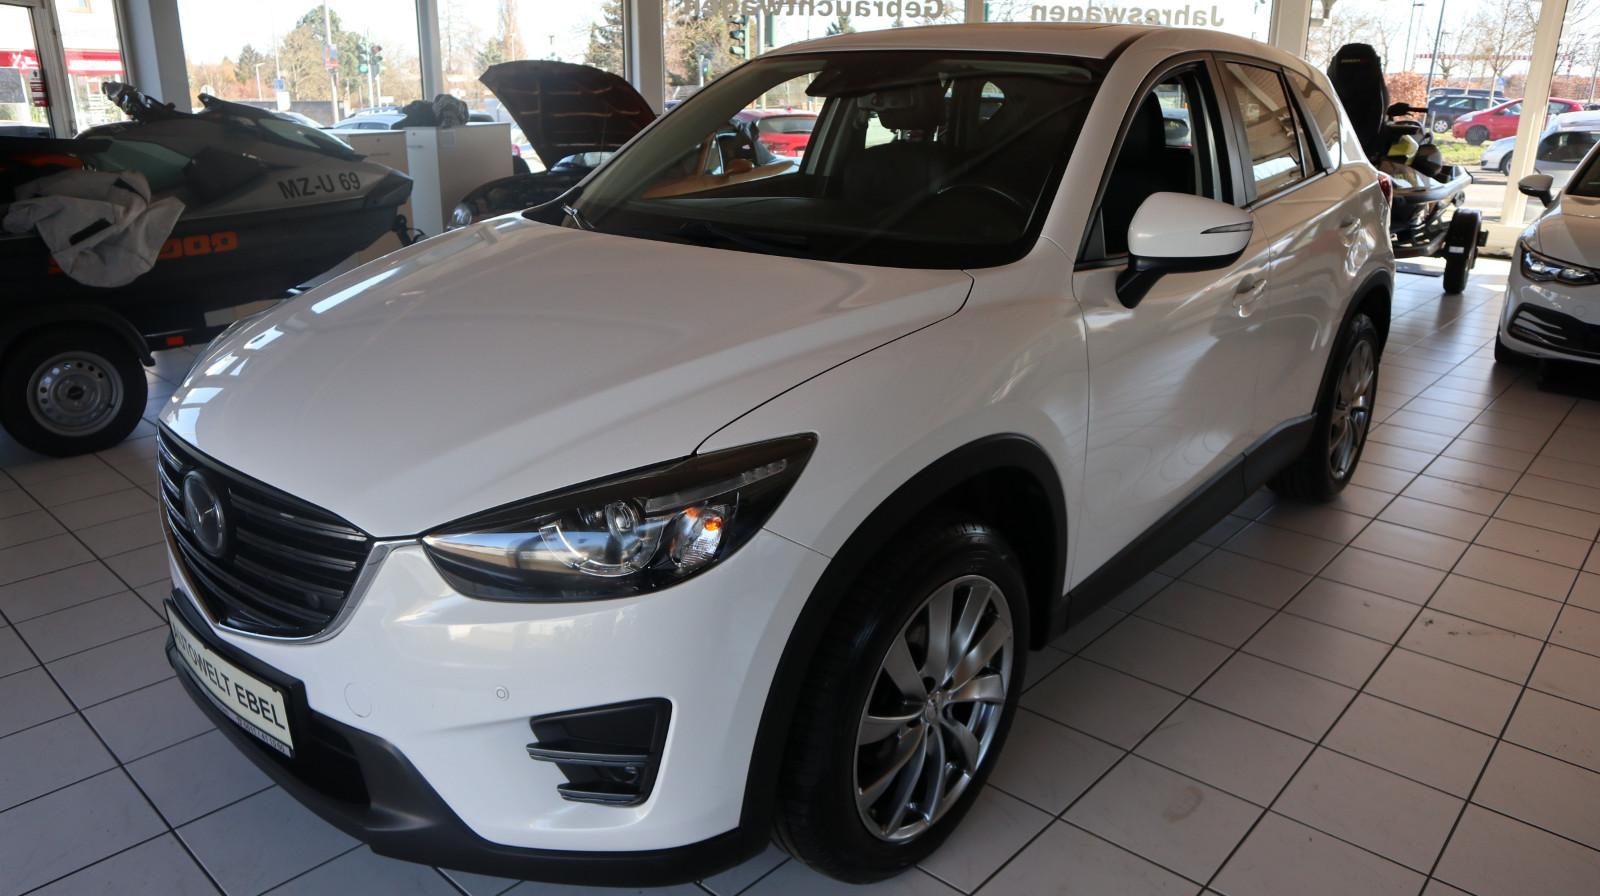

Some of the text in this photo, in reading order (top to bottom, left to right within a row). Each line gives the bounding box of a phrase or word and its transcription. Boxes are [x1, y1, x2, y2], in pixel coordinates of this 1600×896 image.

[277, 172, 361, 200] MZ-U 69
[234, 682, 286, 730] EBEL
